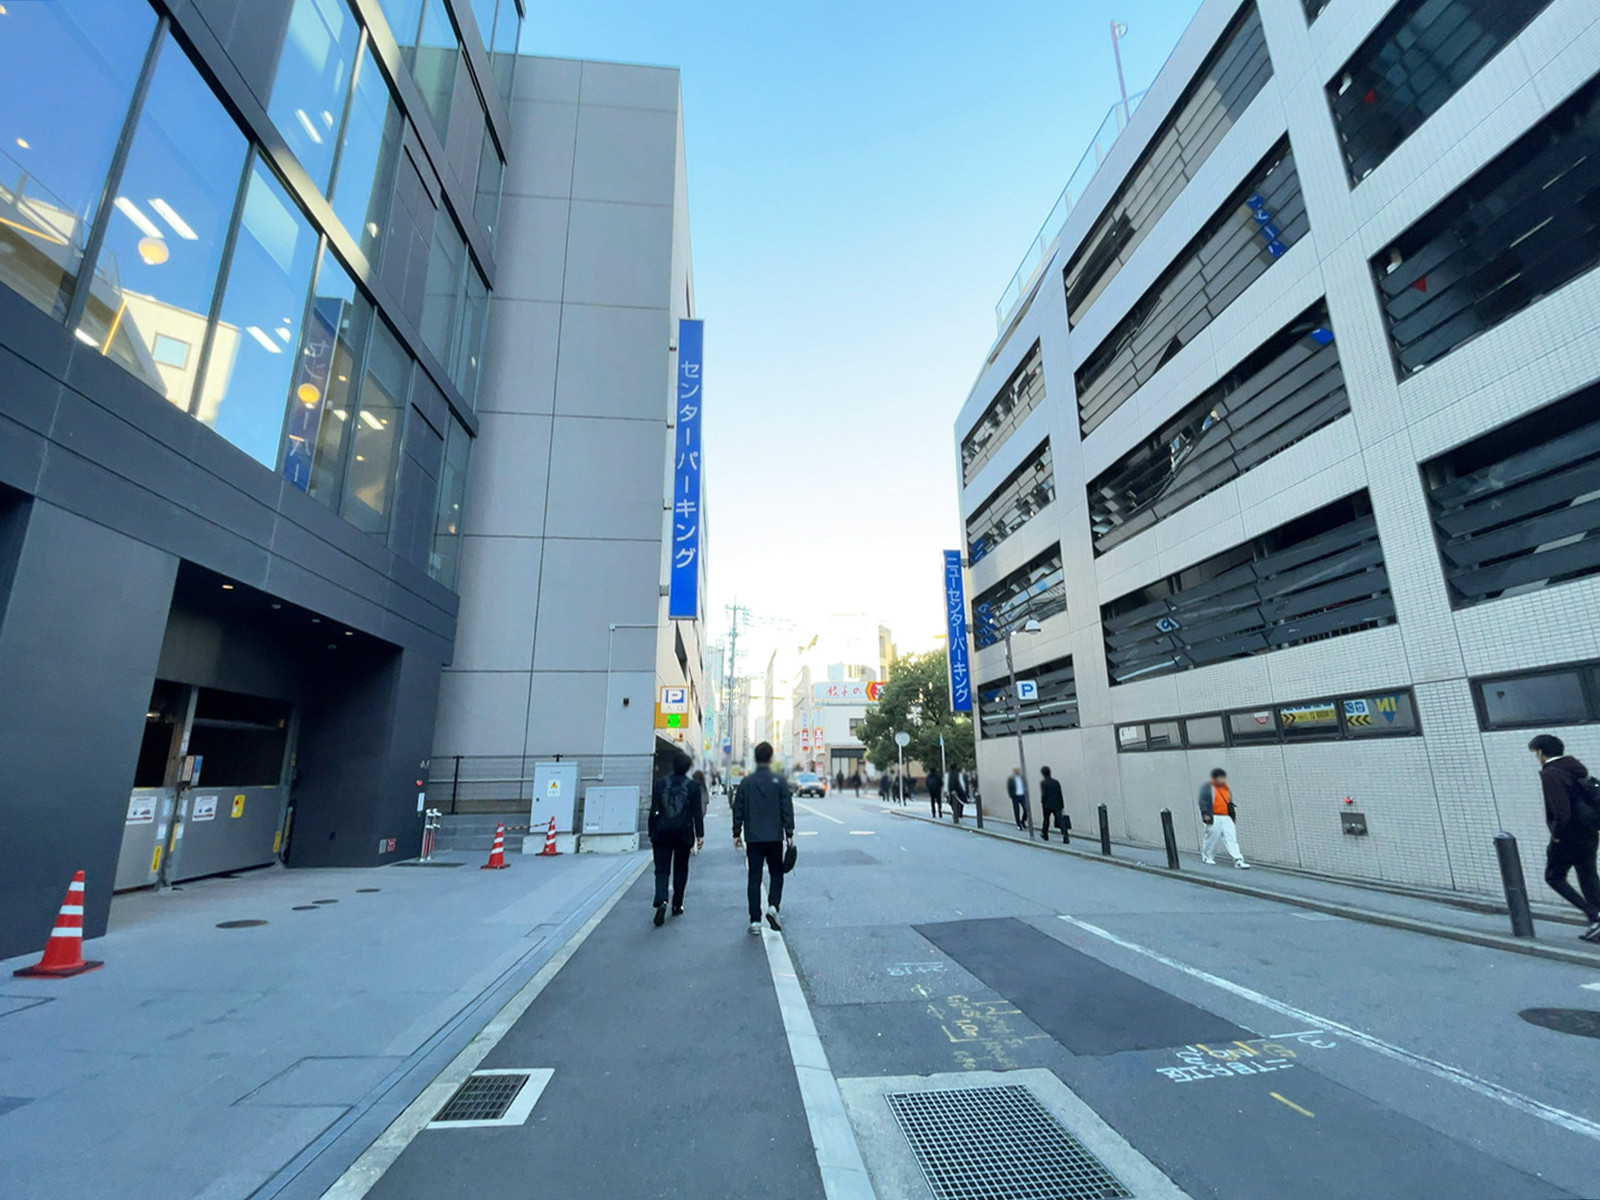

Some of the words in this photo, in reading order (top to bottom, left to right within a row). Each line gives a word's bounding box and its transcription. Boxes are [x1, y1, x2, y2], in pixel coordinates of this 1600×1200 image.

[675, 361, 700, 568] センターパーキング
[946, 558, 969, 703] ニューセンターパーキング
[667, 689, 683, 703] P
[1021, 684, 1034, 697] P
